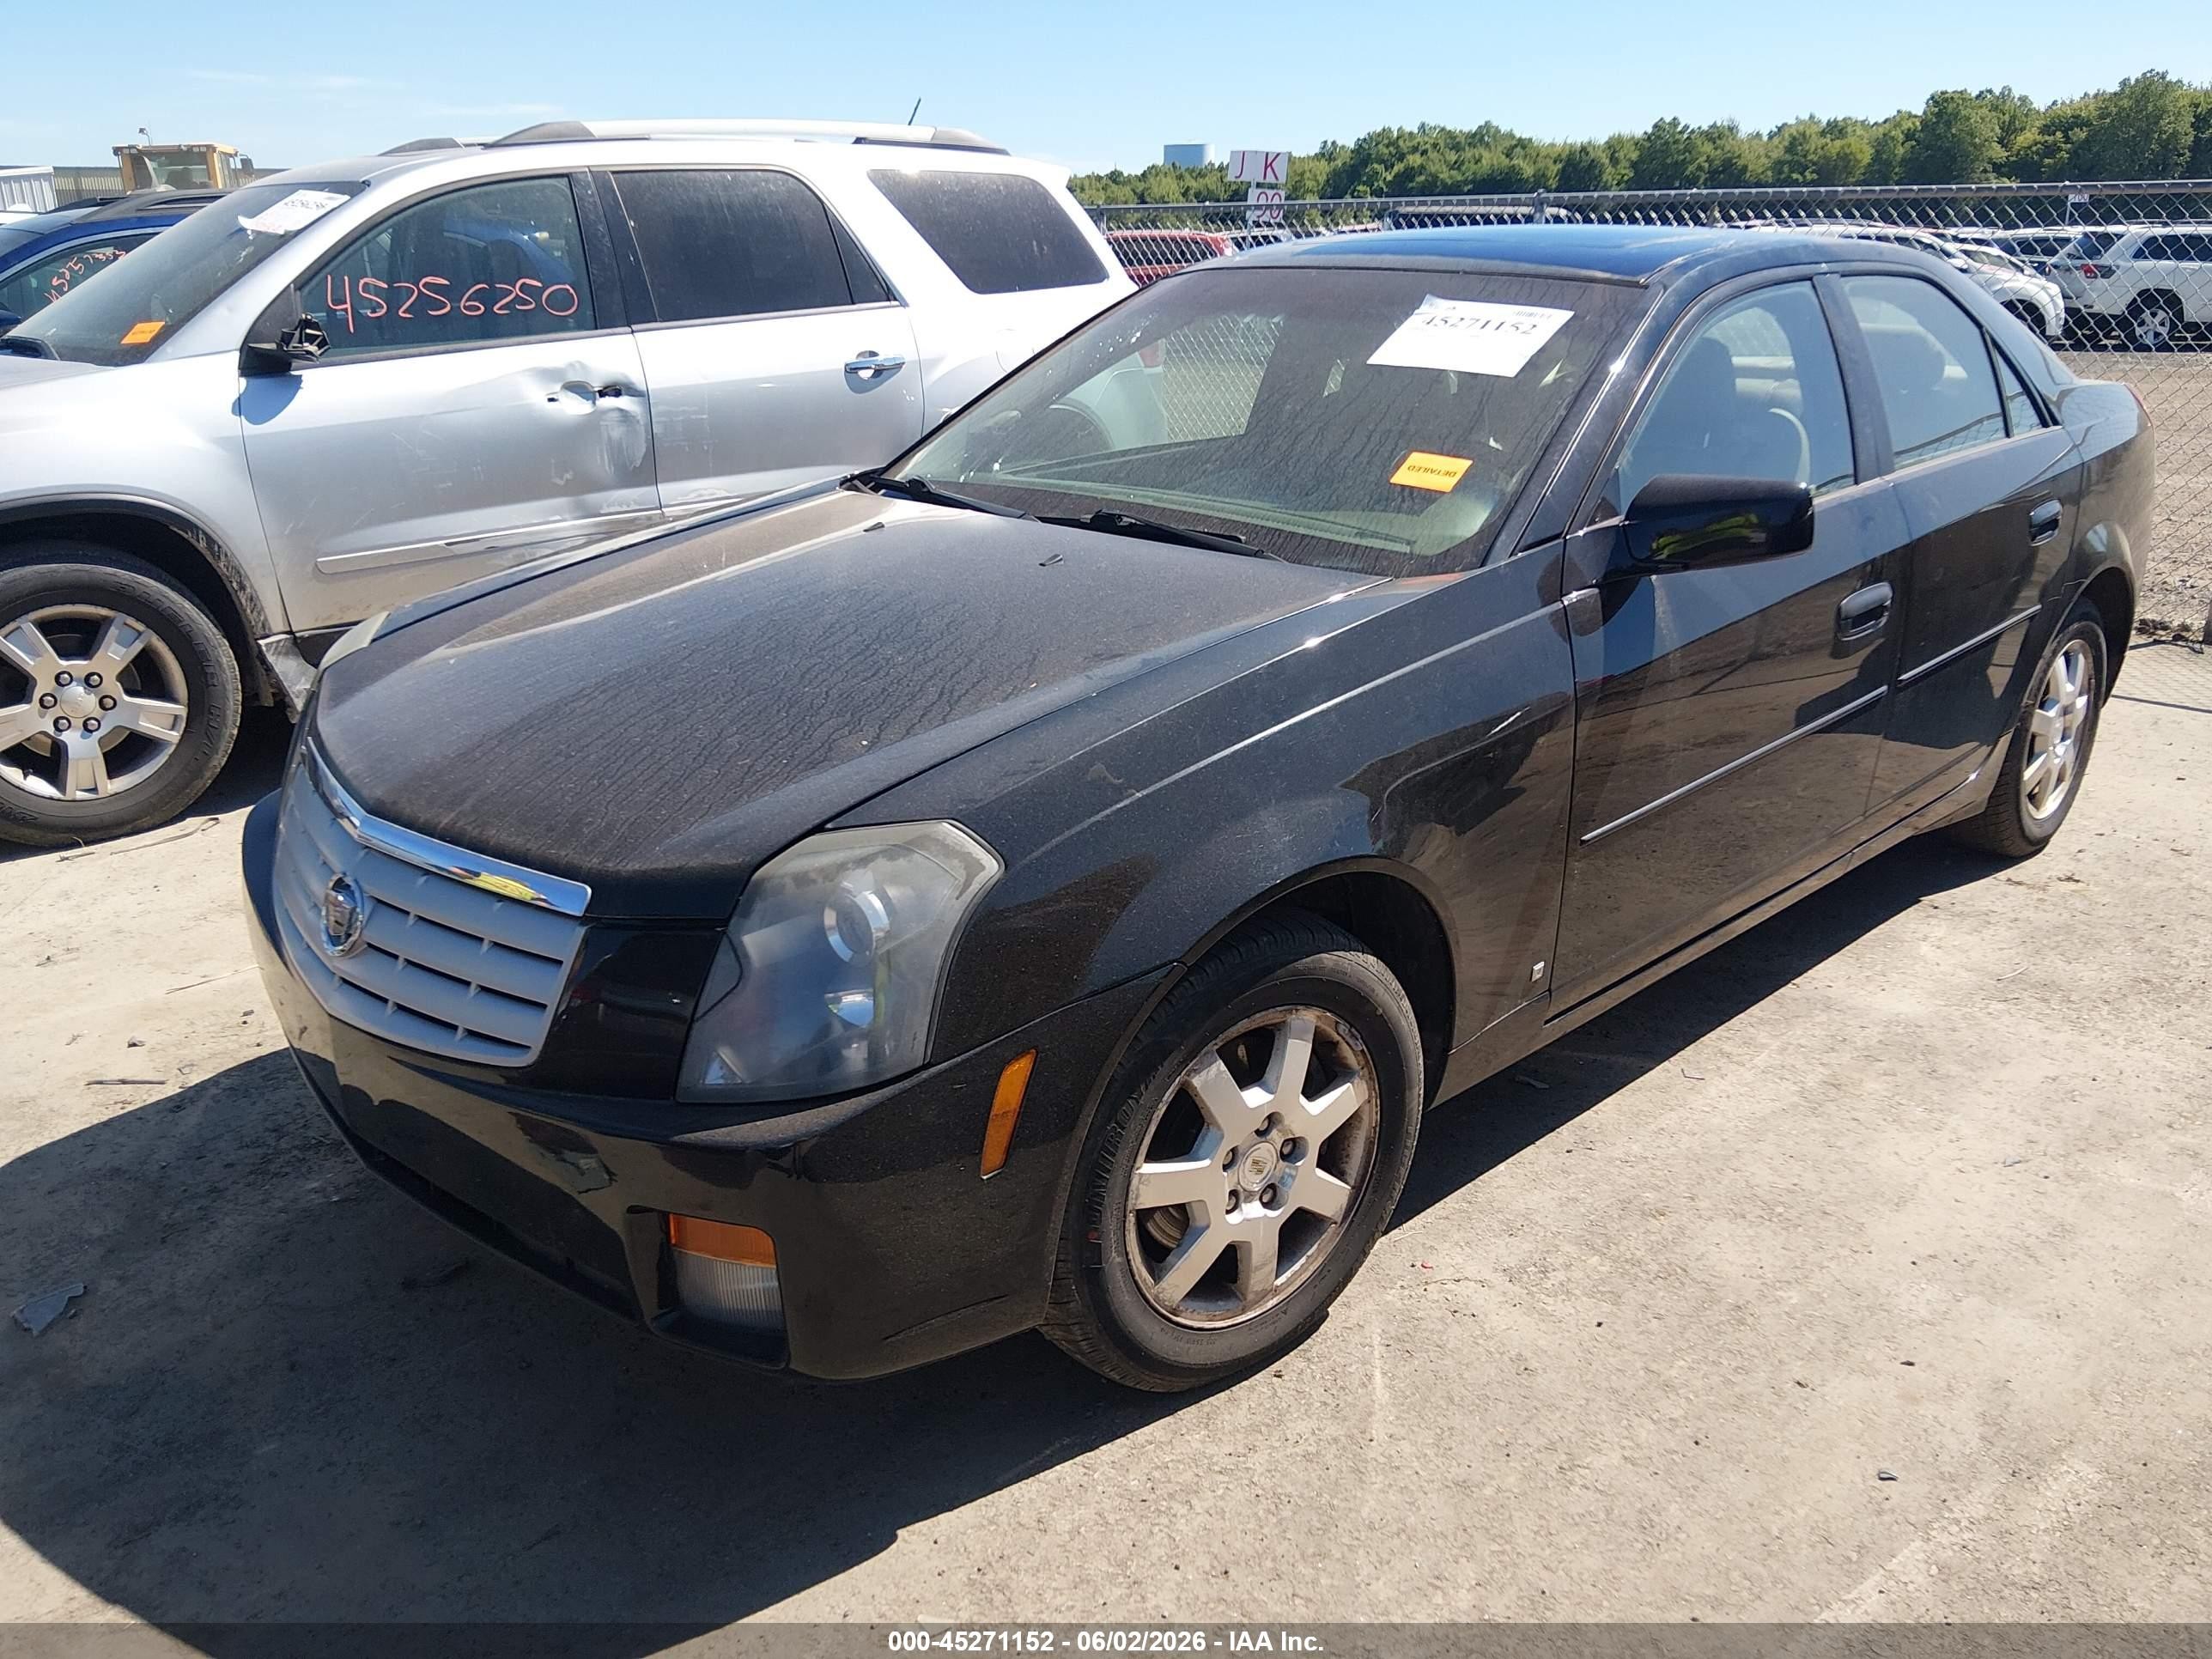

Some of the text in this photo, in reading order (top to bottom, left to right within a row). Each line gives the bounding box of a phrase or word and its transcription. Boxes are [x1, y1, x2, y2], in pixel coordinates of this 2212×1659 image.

[1235, 151, 1280, 180] J K
[327, 274, 579, 333] 45256250
[1407, 465, 1457, 478] DETAILED
